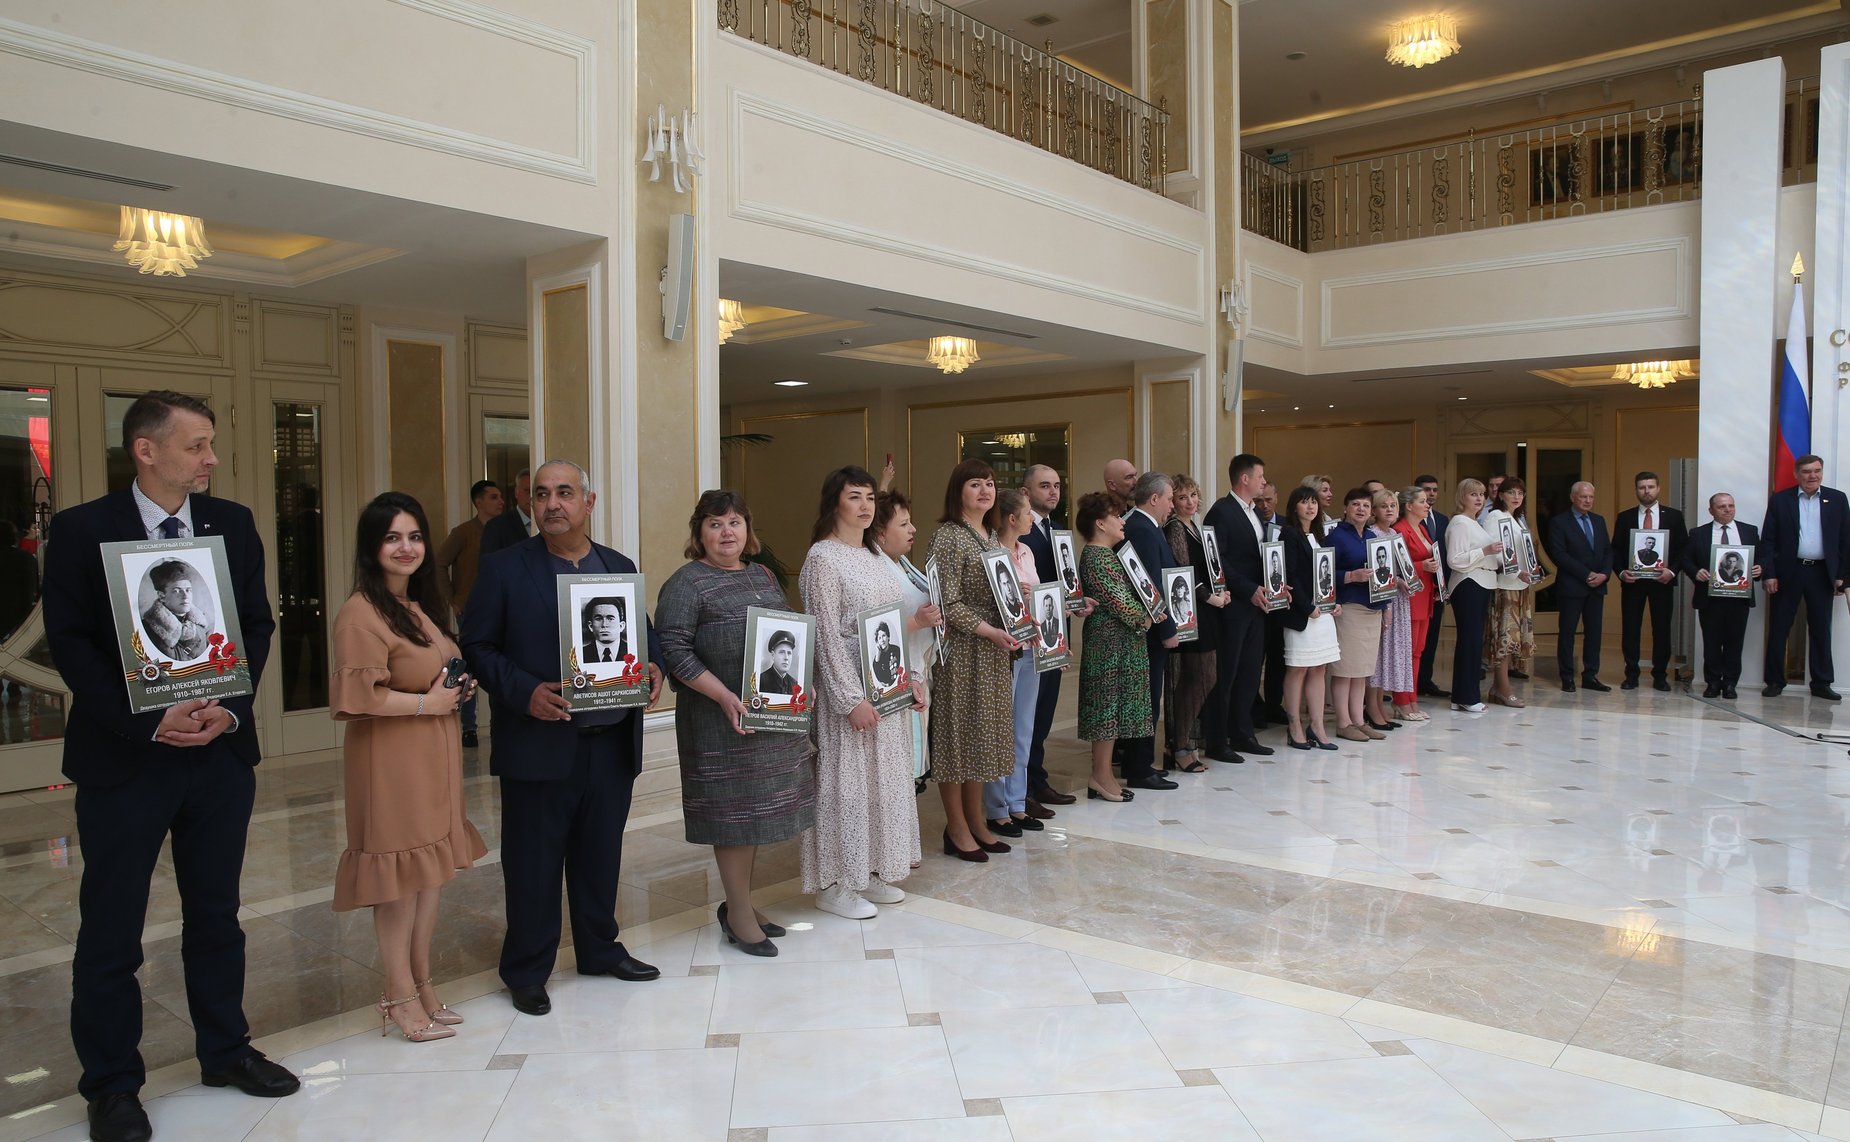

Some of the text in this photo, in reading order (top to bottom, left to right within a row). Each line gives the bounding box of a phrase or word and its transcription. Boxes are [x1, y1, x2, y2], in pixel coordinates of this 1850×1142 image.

[1829, 329, 1850, 347] С
[145, 674, 237, 695] ЕГОРОВ АЛЕКСЕЙ ЯКОВЛЕВИЧ
